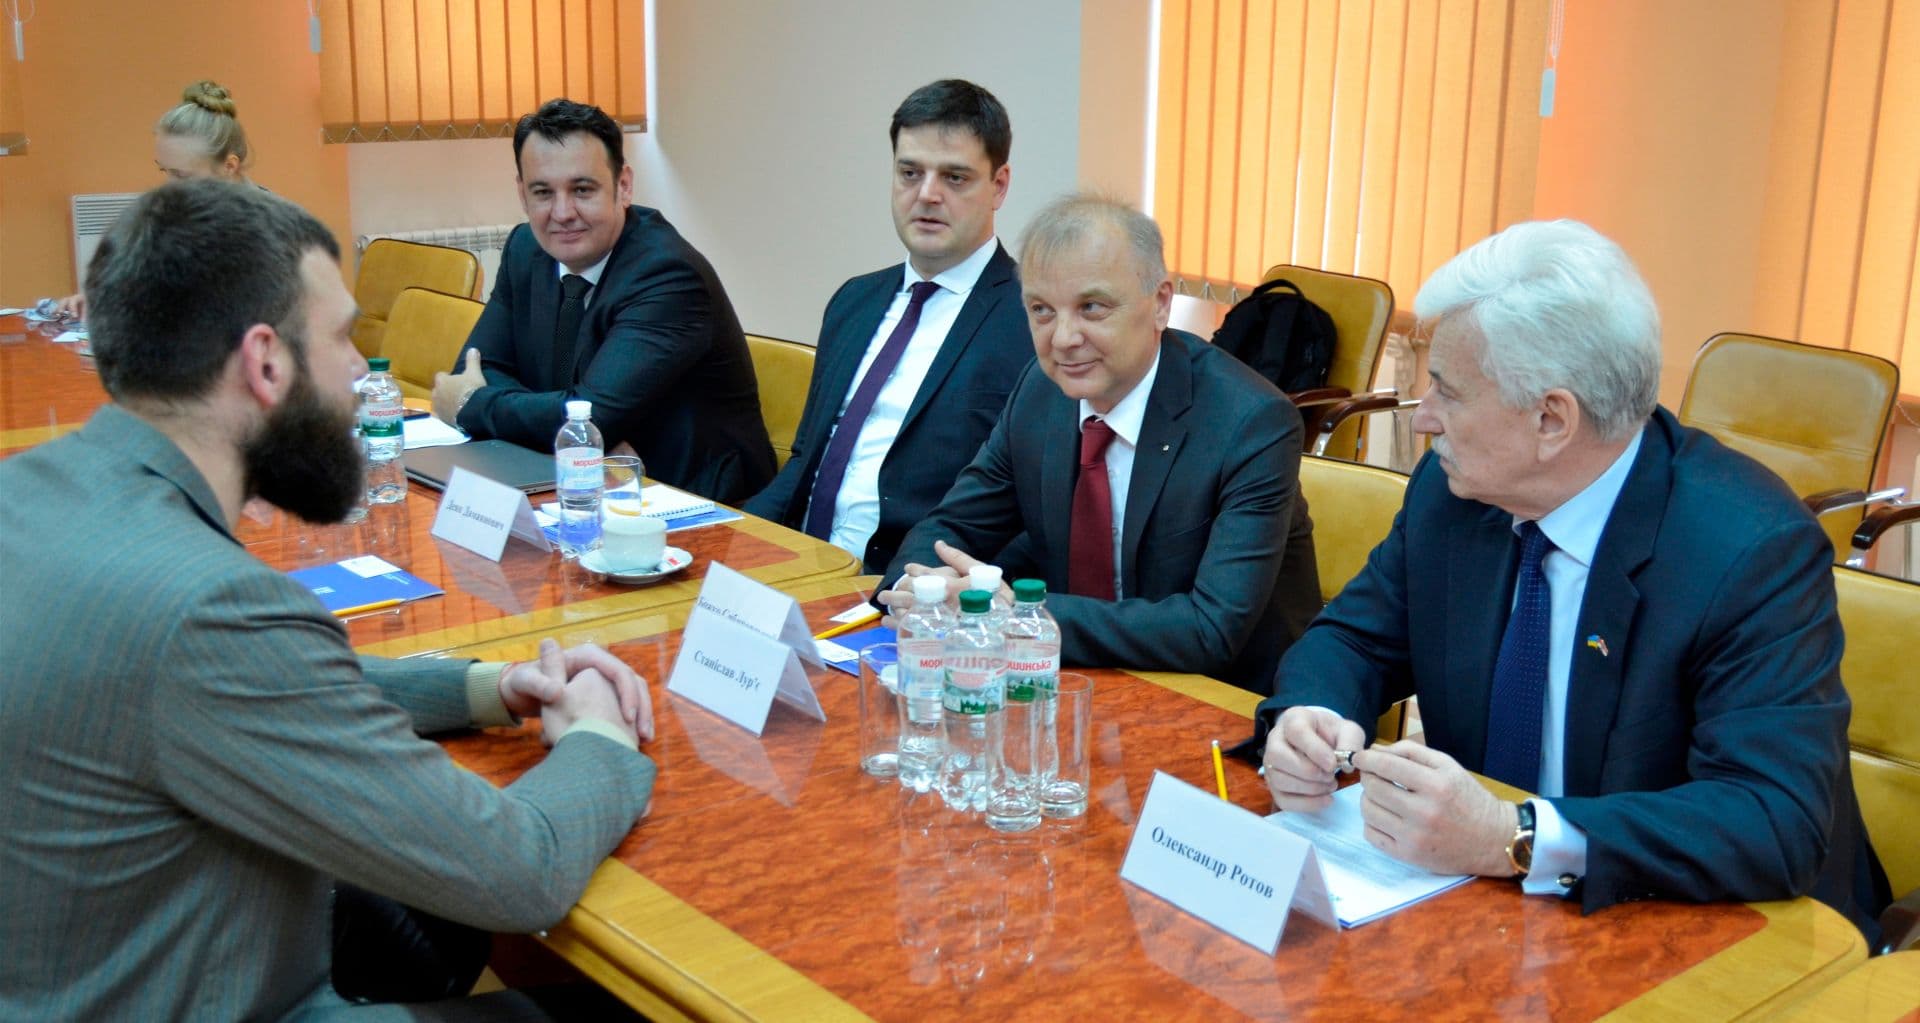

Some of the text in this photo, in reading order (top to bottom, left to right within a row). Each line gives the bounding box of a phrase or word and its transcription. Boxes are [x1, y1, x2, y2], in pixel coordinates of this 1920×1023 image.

[694, 649, 735, 679] Станіслав
[1151, 826, 1274, 899] Олександр Ротов
